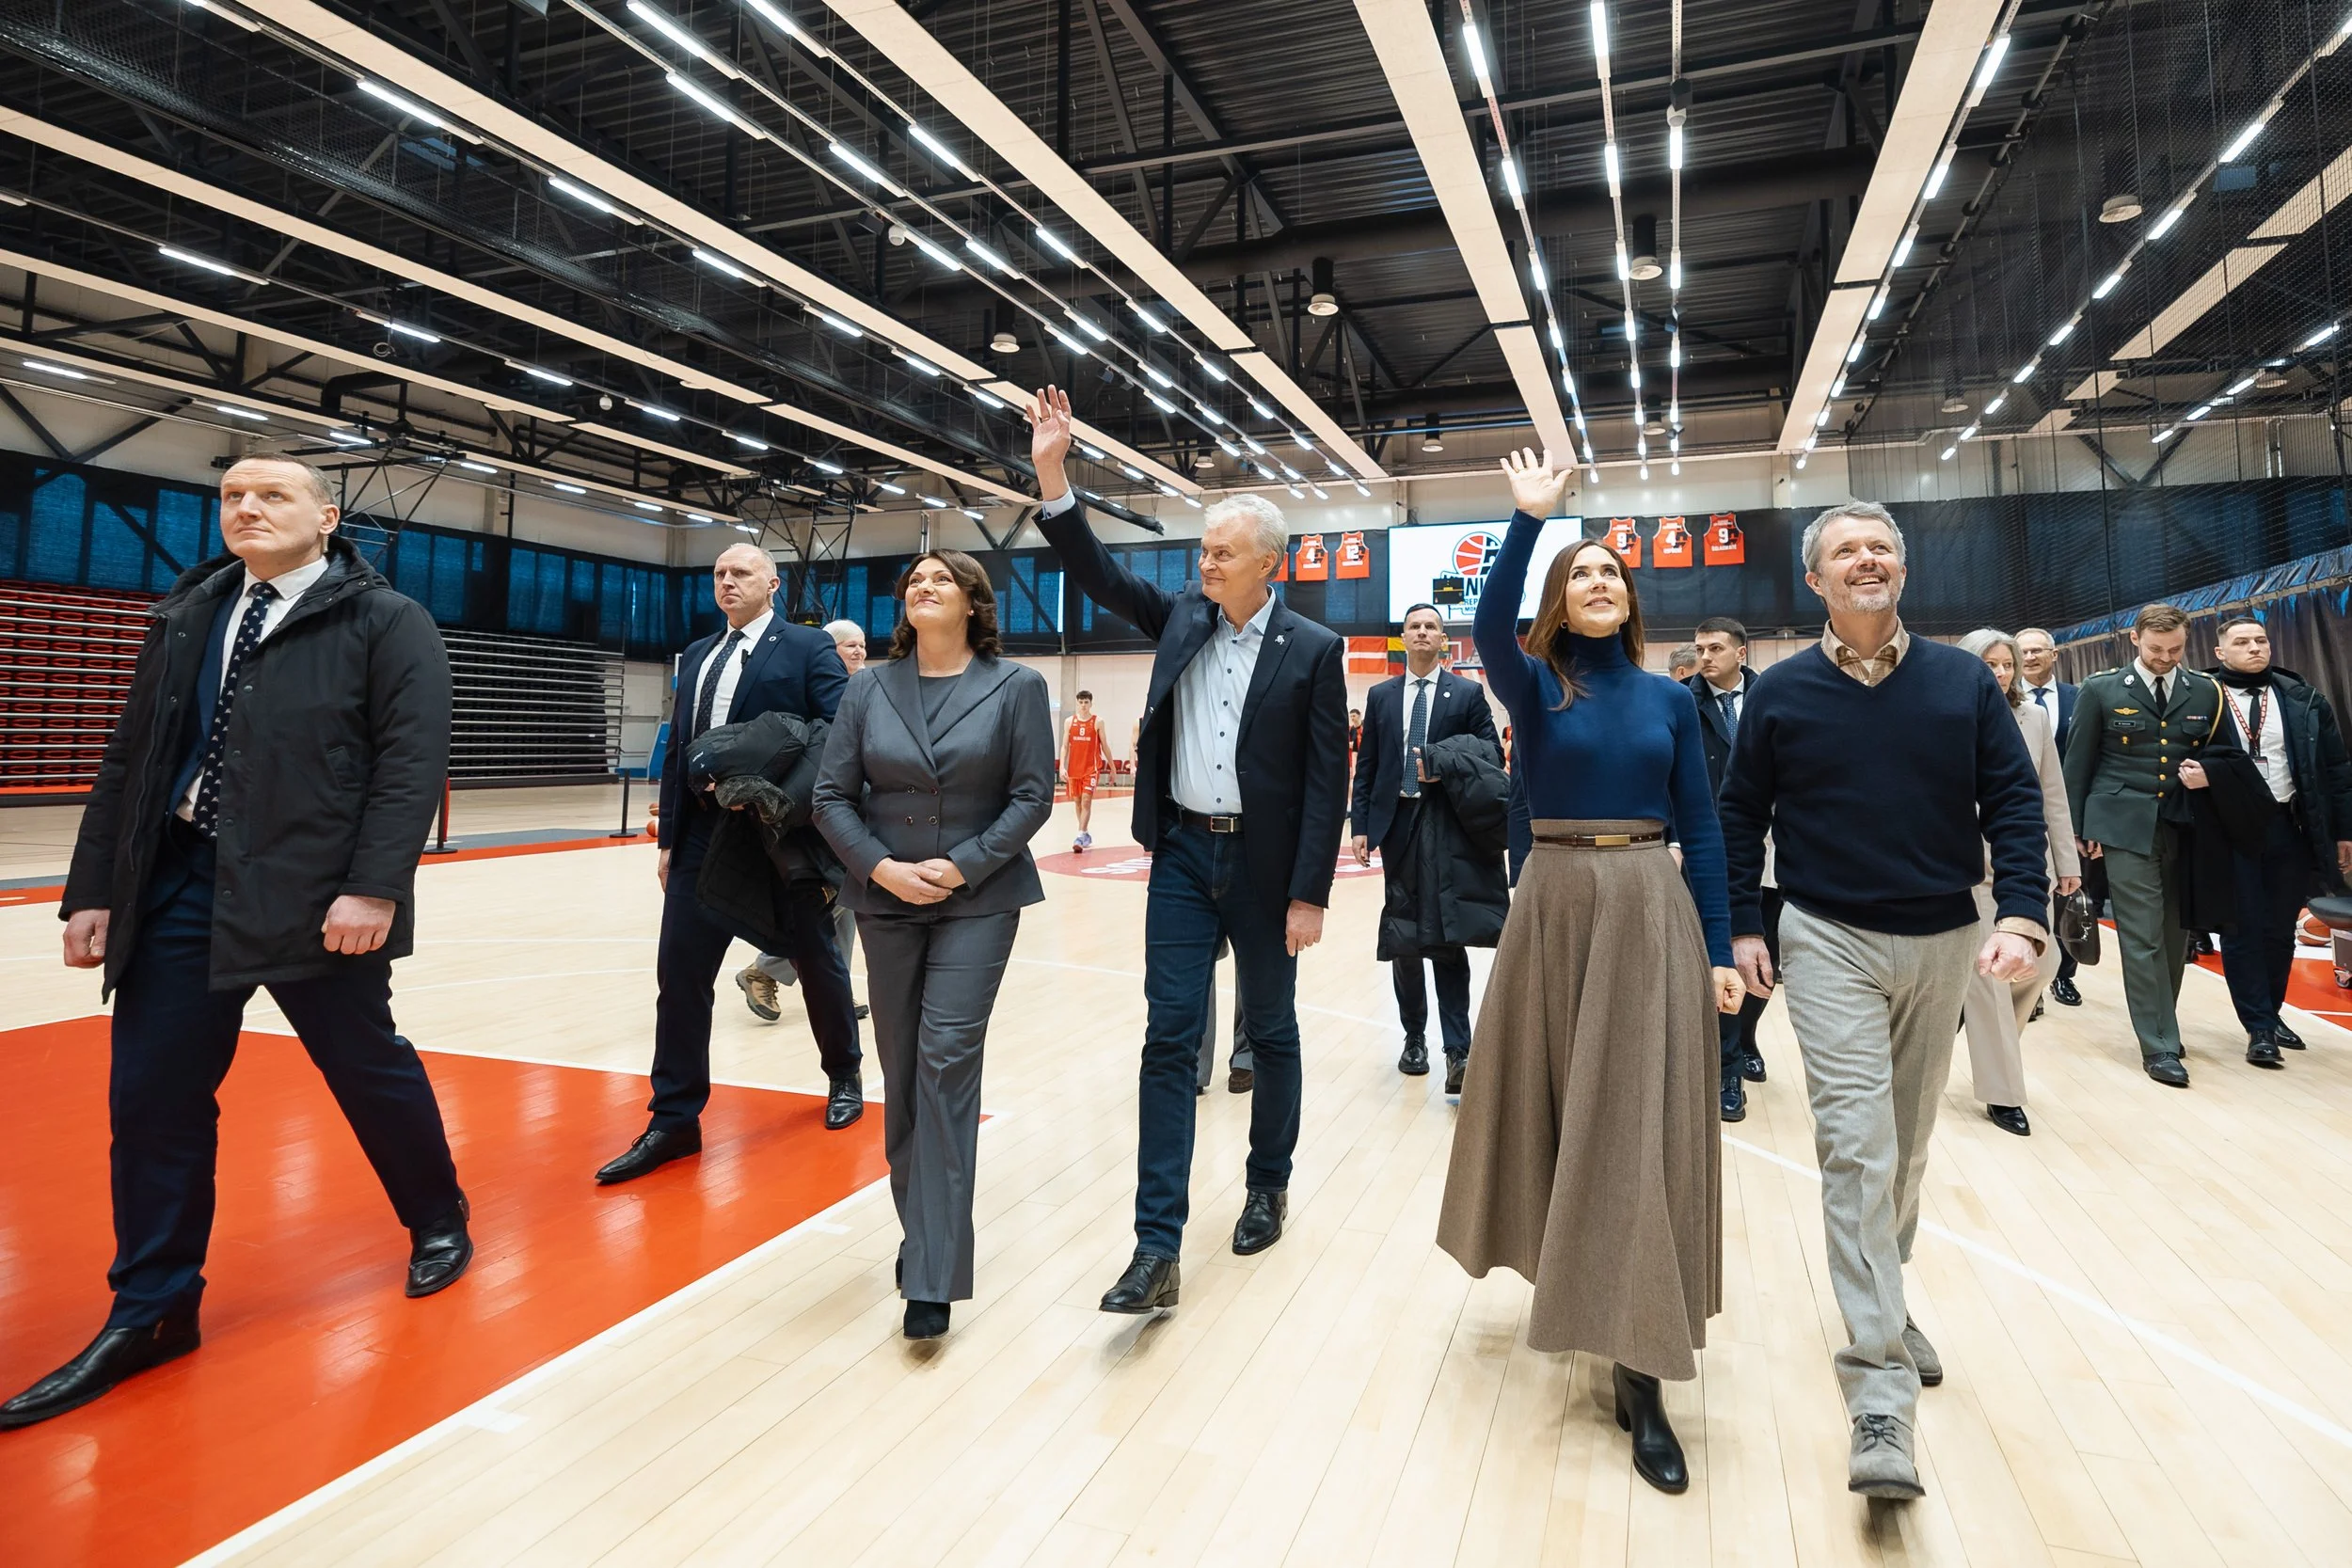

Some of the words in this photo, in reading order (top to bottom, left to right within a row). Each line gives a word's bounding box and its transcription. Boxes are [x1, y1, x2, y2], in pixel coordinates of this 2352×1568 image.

[1665, 531, 1677, 546] 4
[1719, 528, 1729, 544] 9
[1306, 546, 1315, 562] 4
